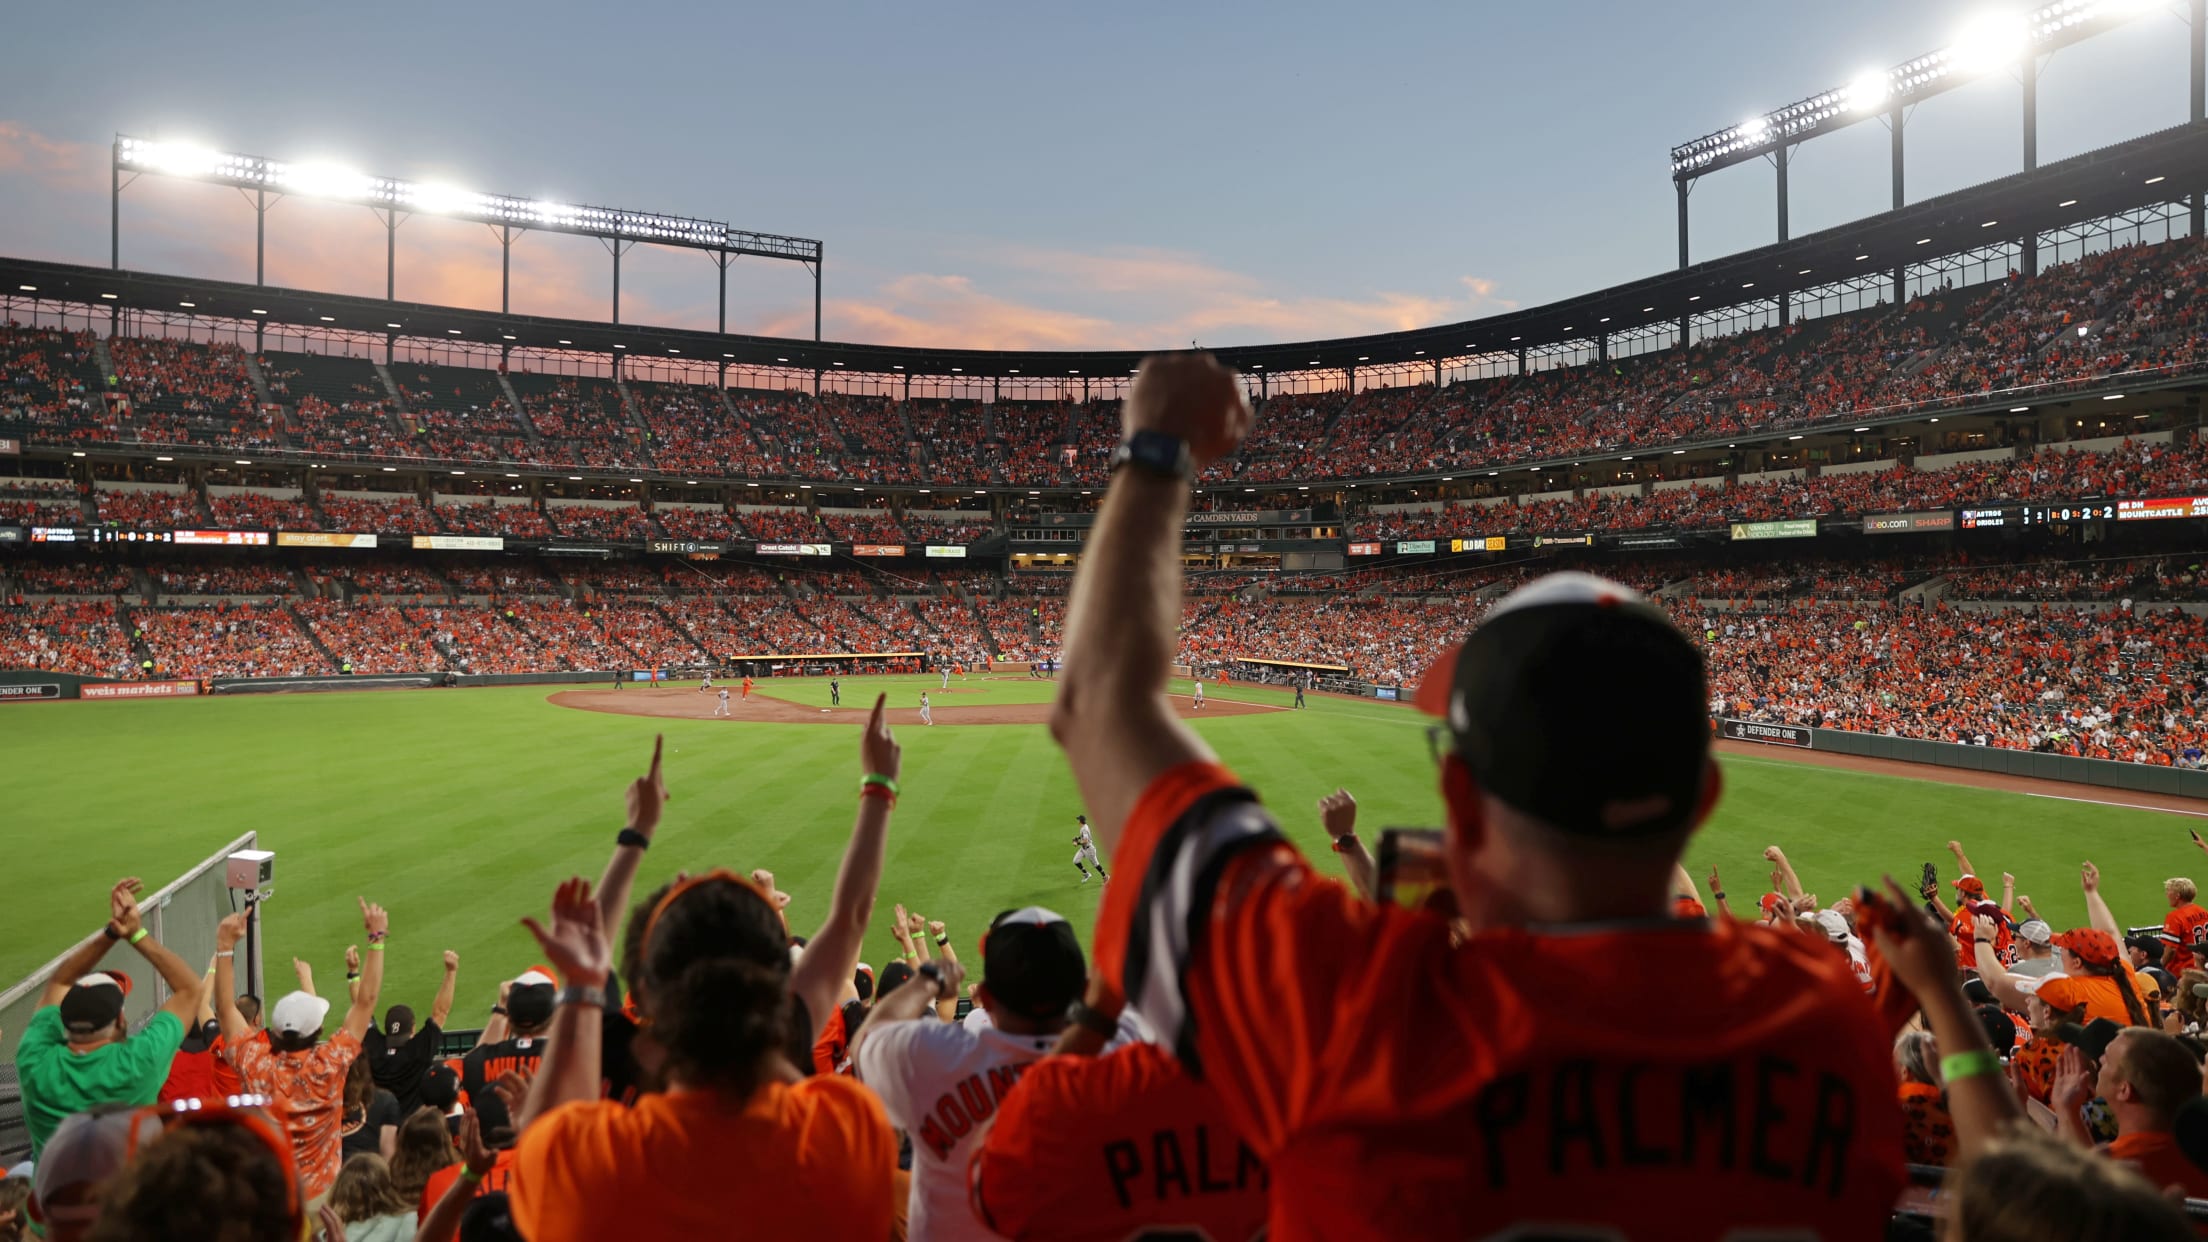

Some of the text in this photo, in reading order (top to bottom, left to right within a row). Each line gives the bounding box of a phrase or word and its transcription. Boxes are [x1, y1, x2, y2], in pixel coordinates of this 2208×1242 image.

[2131, 501, 2144, 509] DH
[1193, 513, 1230, 522] CAMDEN
[1231, 513, 1258, 522] YARDS
[1976, 510, 2002, 518] ASTROS
[2082, 508, 2091, 520] 2
[2103, 506, 2113, 519] 2
[2119, 508, 2183, 519] MOUNTCASTLE
[1867, 518, 1951, 529] ubeo.com SHARP
[1976, 518, 2004, 526] ORIOLES
[145, 532, 154, 542] 2
[163, 532, 171, 542] 2
[25, 686, 42, 695] ONE
[84, 685, 115, 696] weis
[117, 682, 172, 695] markets
[1747, 725, 1781, 738] DEFENDER
[1781, 729, 1797, 740] ONE
[1477, 1054, 1856, 1199] PALMER
